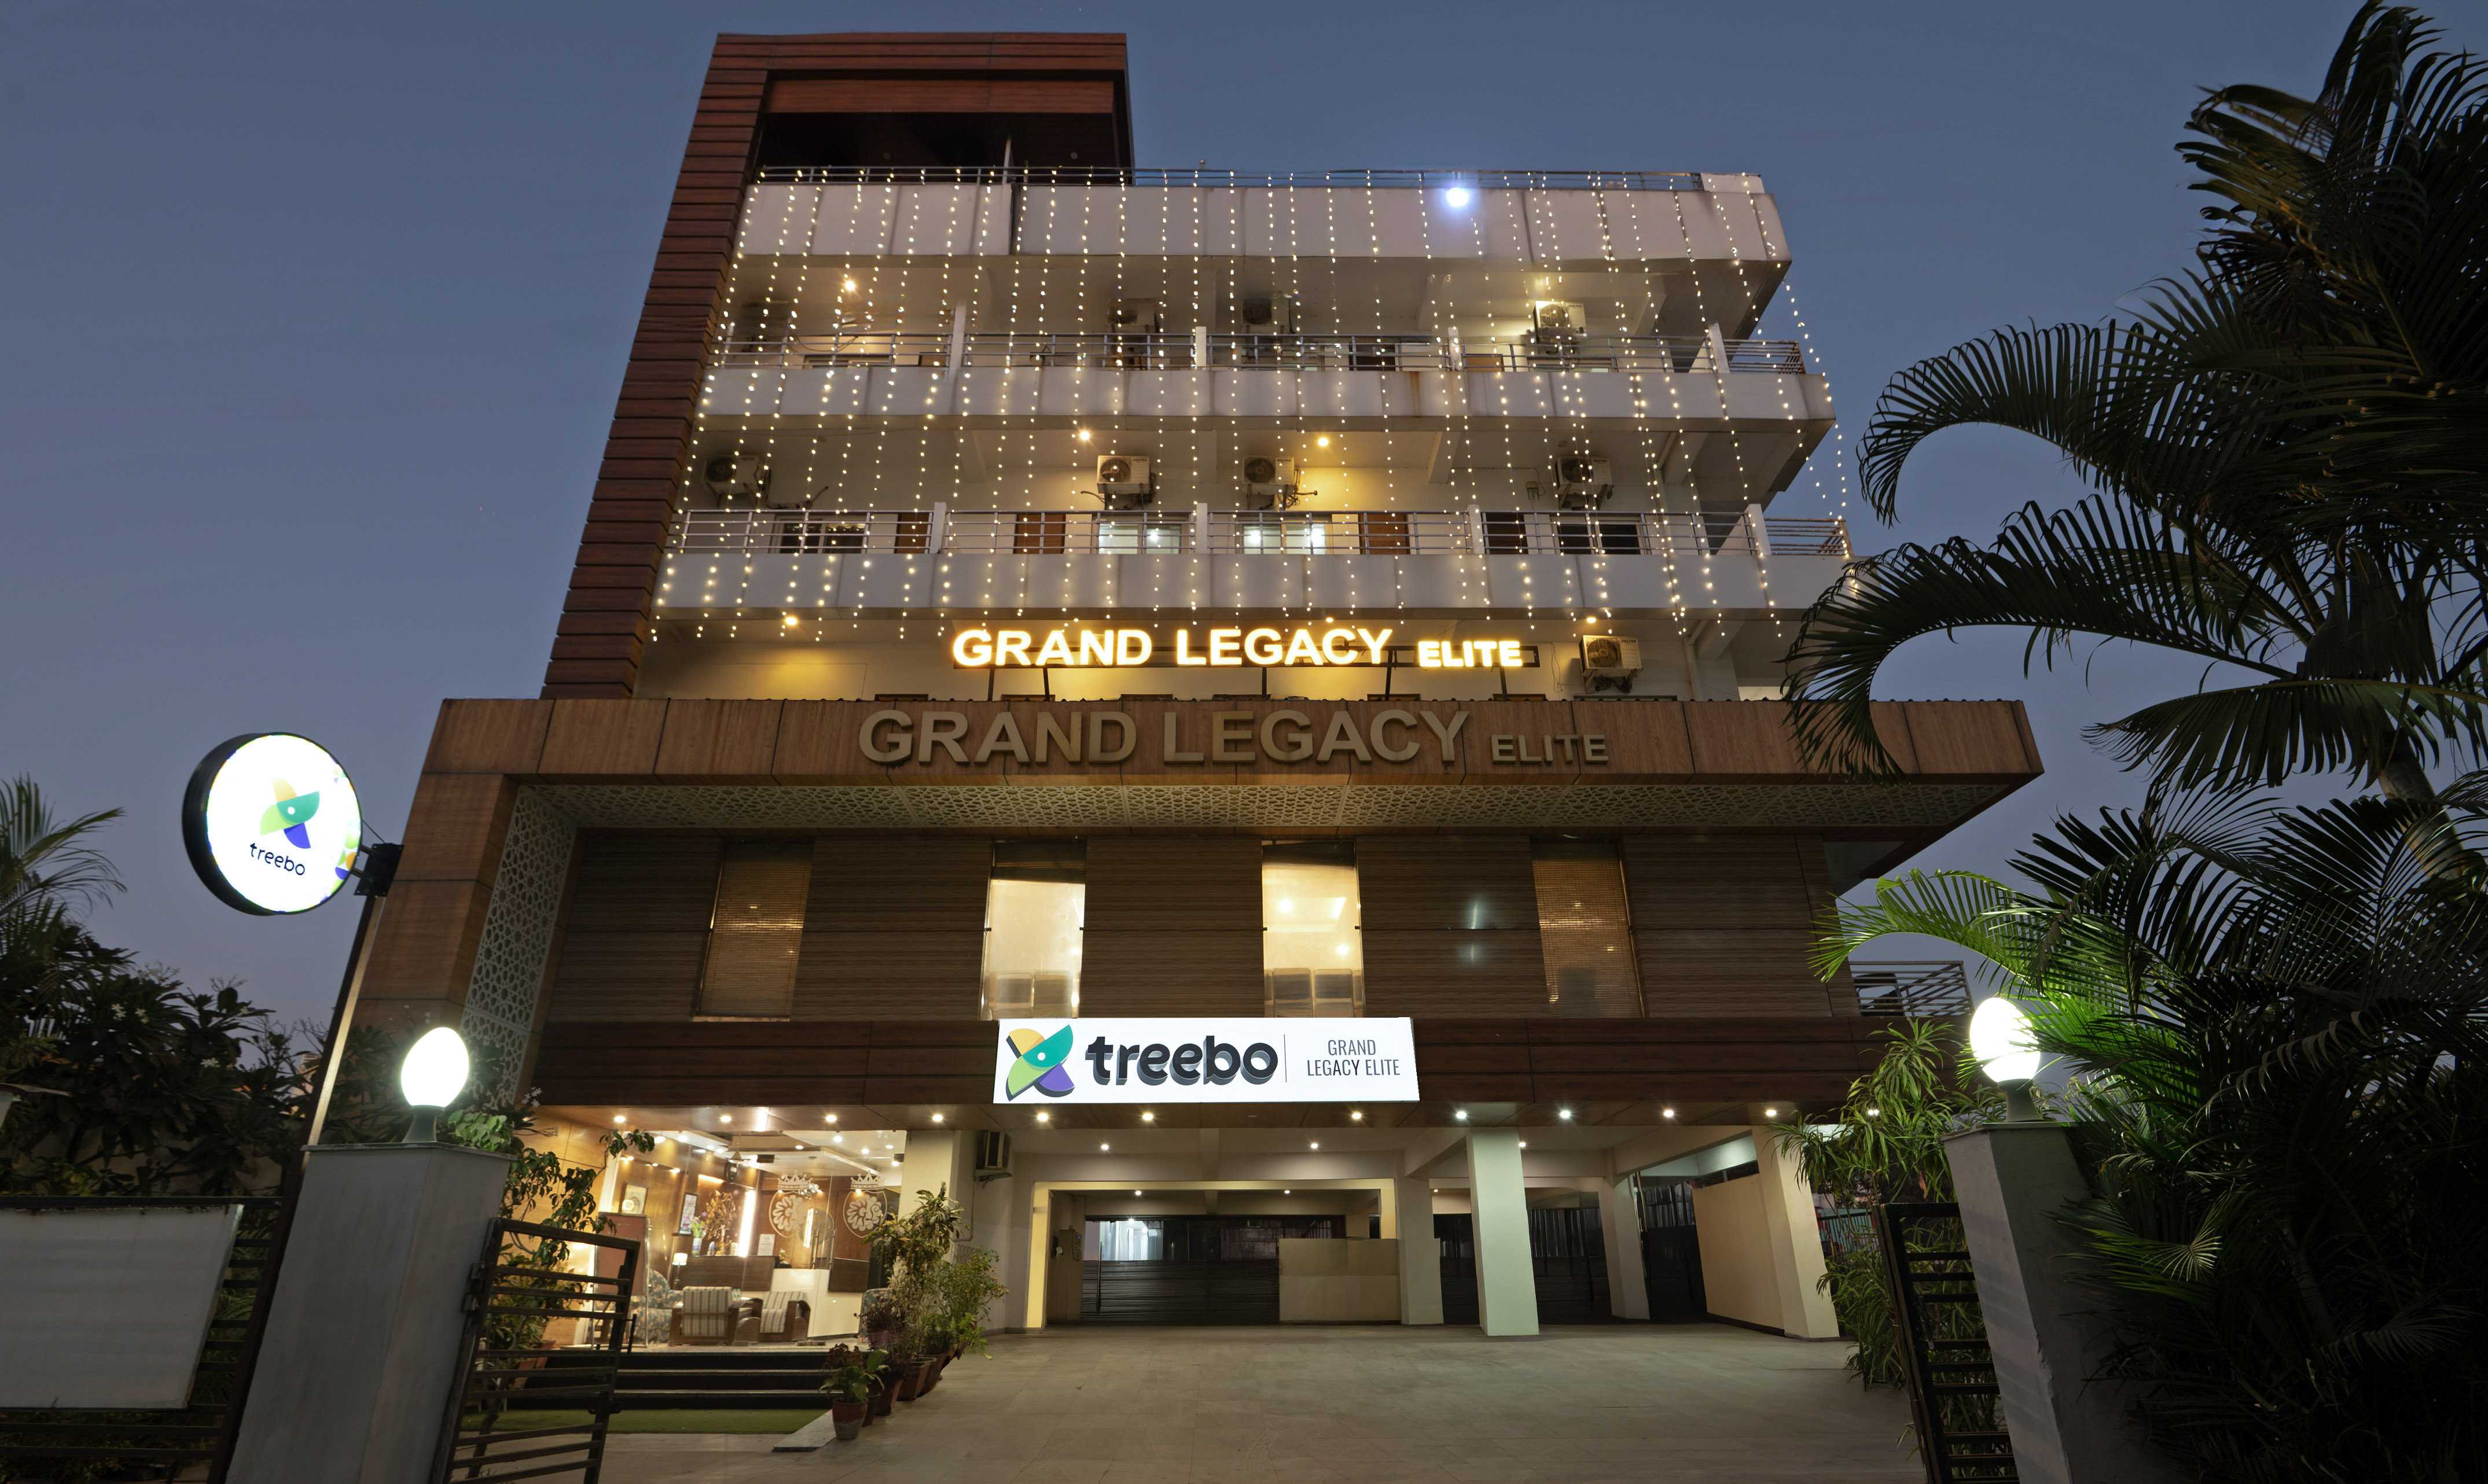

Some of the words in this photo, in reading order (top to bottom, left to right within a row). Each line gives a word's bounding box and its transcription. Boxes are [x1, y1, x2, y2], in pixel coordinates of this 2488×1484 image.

[953, 628, 1152, 666] GRAND
[1176, 628, 1393, 665] LEGACY
[1417, 640, 1523, 668] ELITE
[859, 709, 1137, 764] GRAND
[1163, 709, 1470, 764] LEGACY
[1490, 734, 1609, 764] ELITE
[249, 842, 306, 876] treebo
[1085, 1035, 1278, 1086] treebo
[1328, 1039, 1376, 1056] GRAND
[1307, 1059, 1360, 1076] LEGACY
[1365, 1059, 1401, 1076] ELITE
